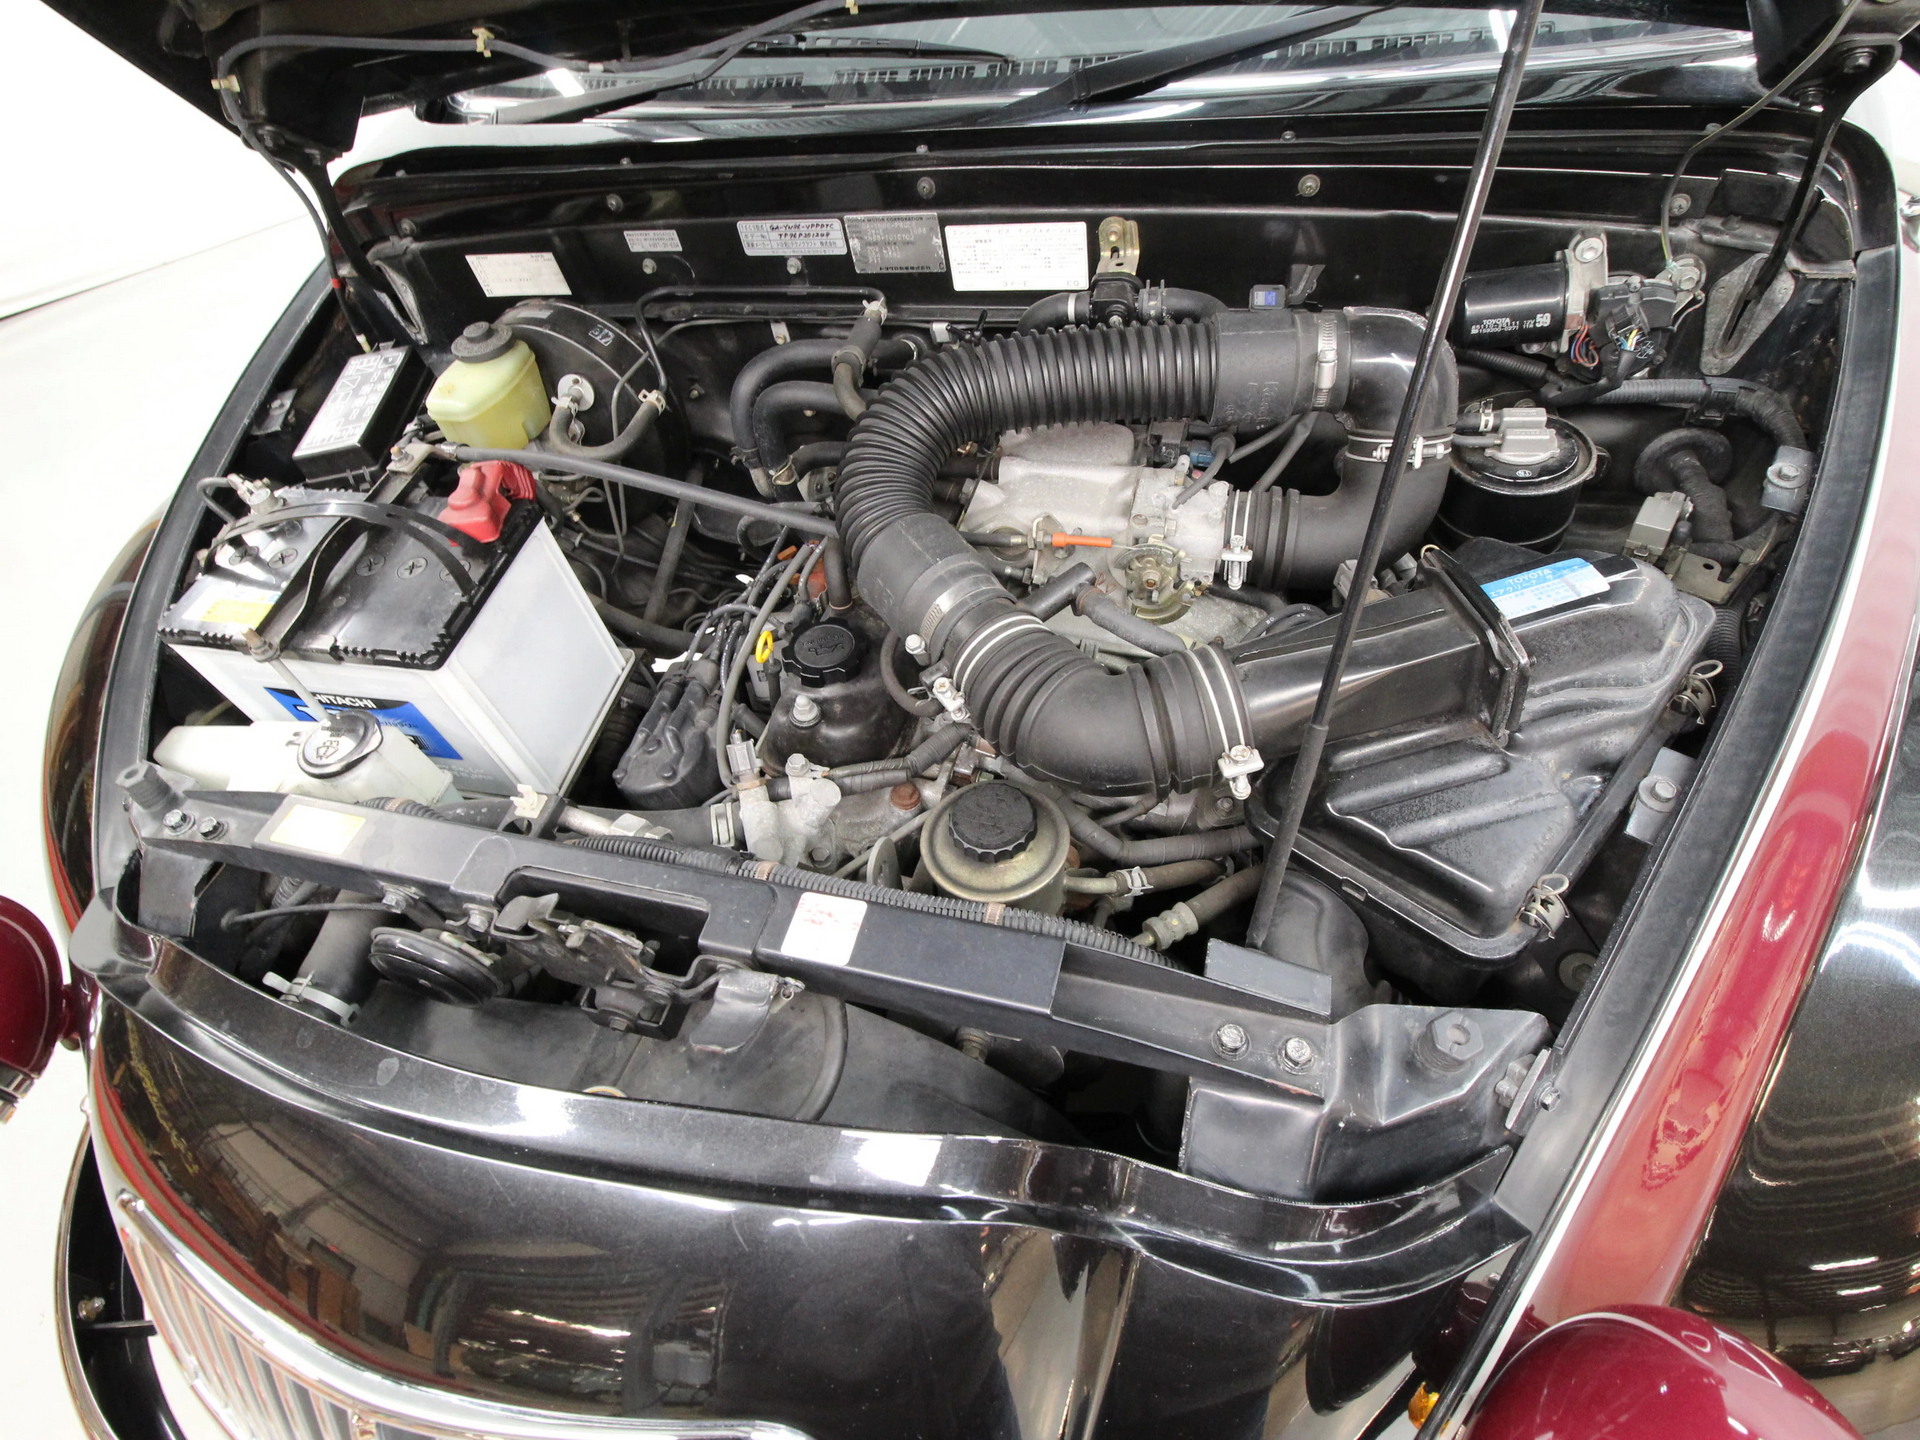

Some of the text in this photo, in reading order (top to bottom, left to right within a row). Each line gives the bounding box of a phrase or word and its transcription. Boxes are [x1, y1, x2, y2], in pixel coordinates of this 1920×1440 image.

[1482, 317, 1511, 325] TOYOTA
[1535, 312, 1552, 328] 59
[1505, 568, 1553, 586] TOYOTA
[314, 694, 377, 709] HITACHI
